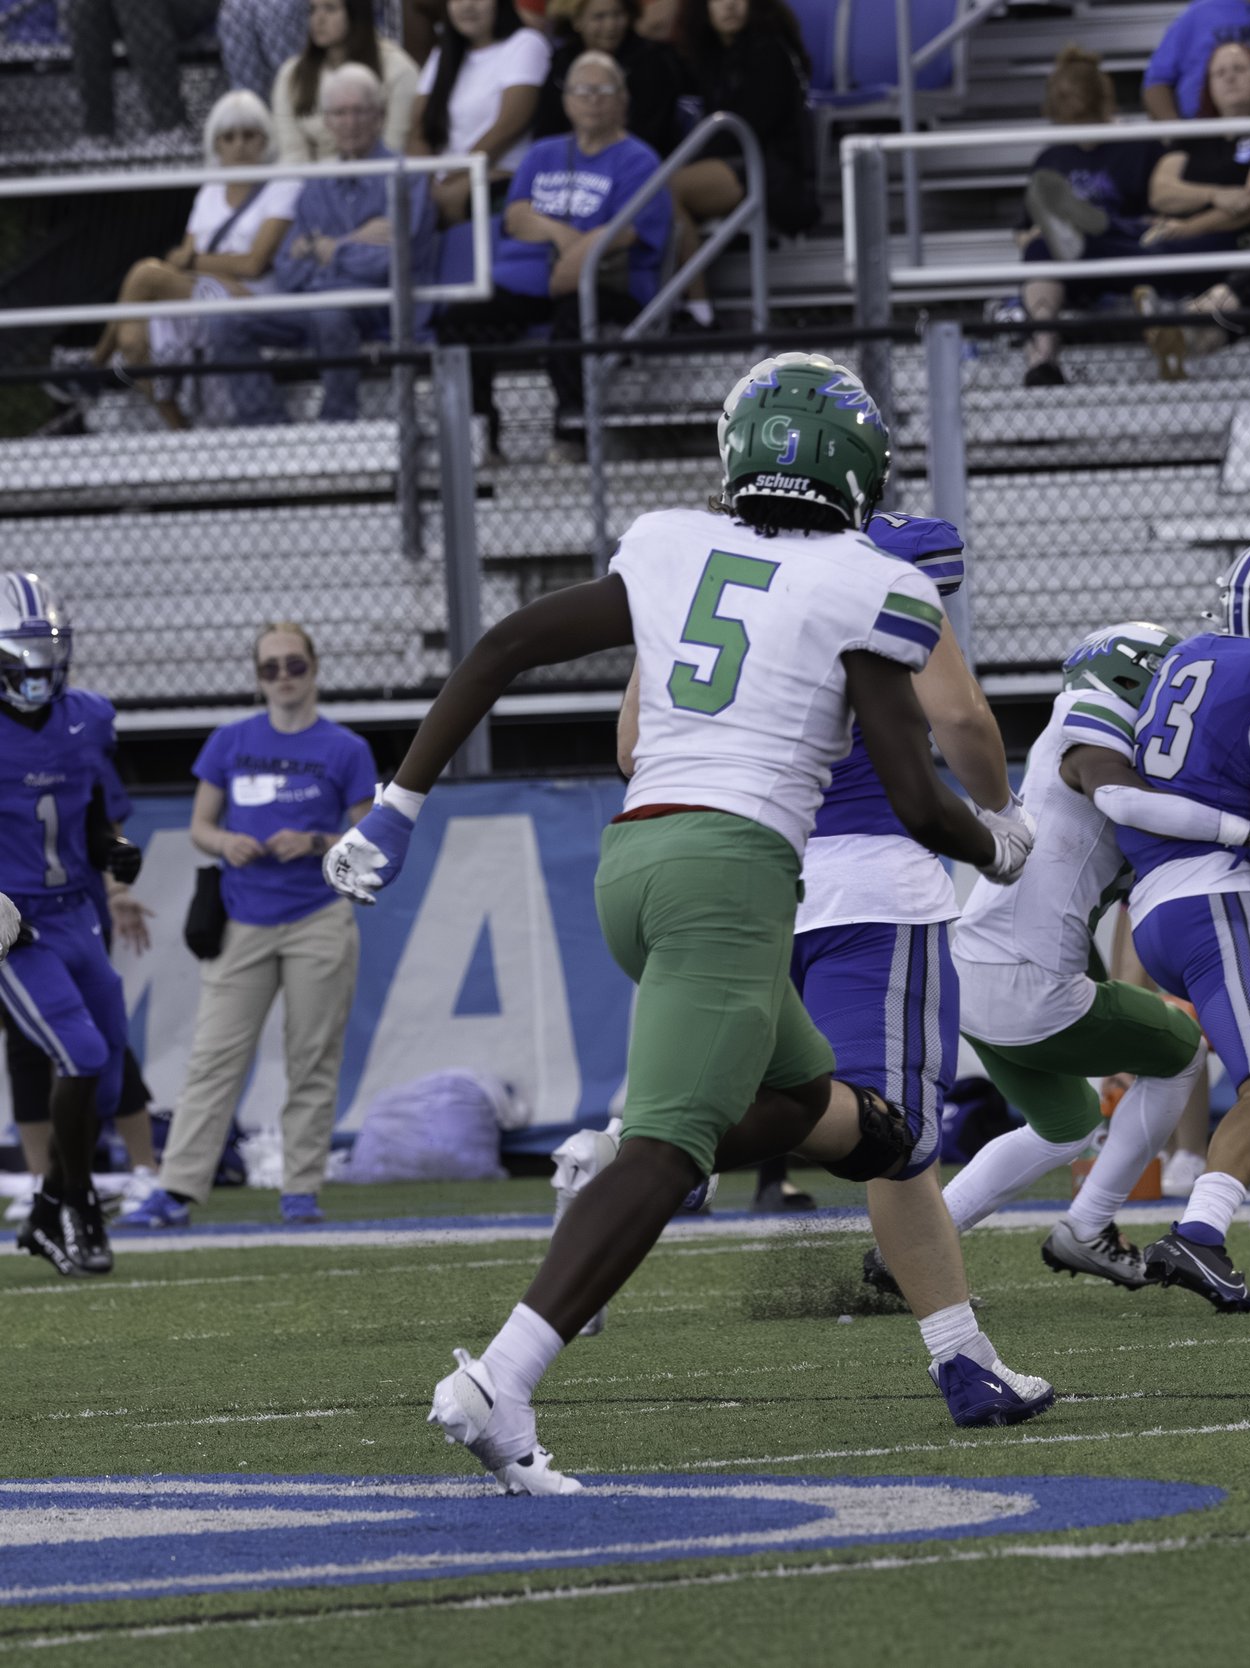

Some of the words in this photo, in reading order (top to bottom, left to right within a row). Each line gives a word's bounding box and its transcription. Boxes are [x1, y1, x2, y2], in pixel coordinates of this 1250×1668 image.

[755, 473, 811, 490] schutt
[667, 548, 781, 716] 5
[1134, 654, 1216, 781] 13
[36, 793, 67, 888] 1
